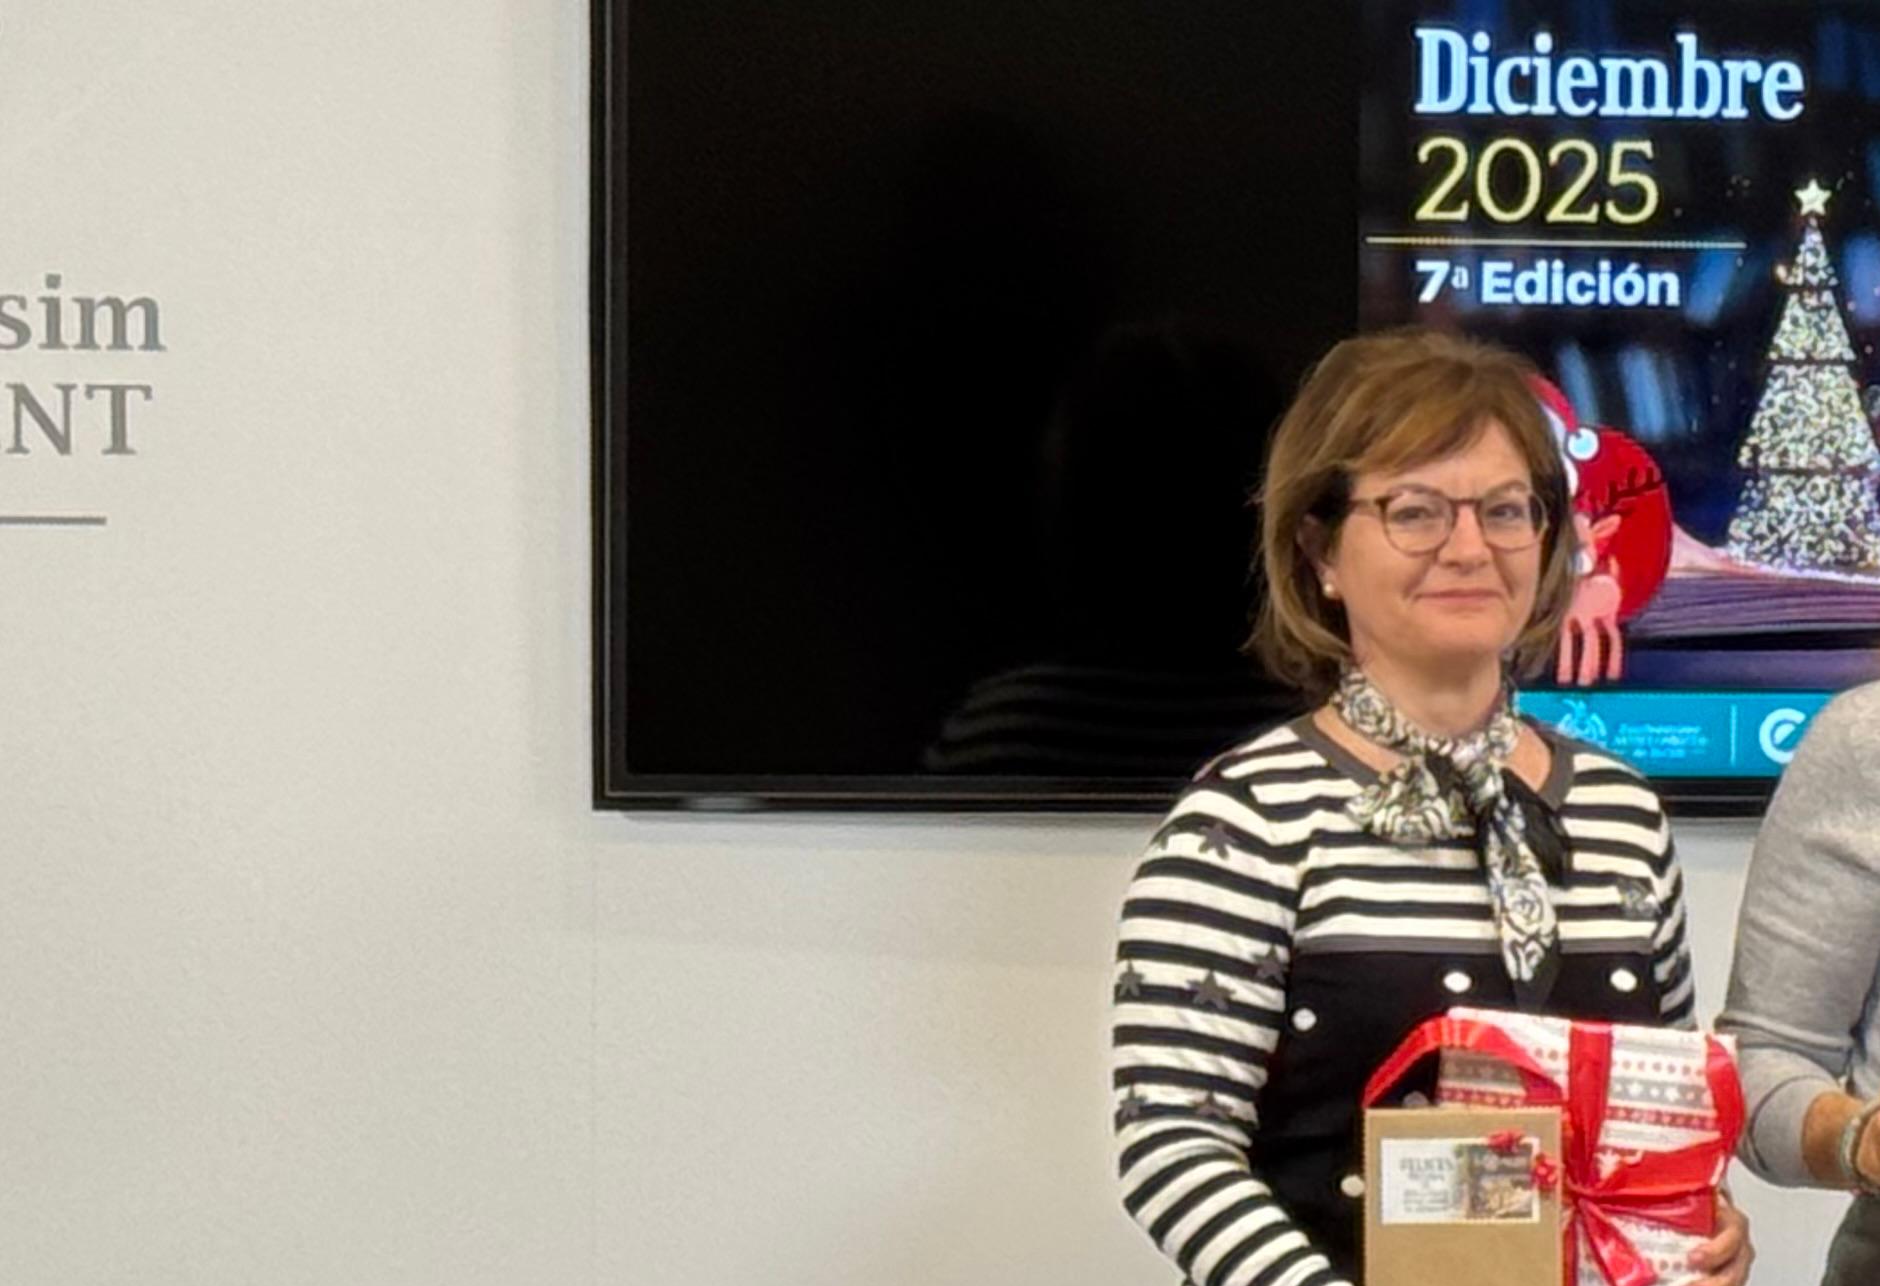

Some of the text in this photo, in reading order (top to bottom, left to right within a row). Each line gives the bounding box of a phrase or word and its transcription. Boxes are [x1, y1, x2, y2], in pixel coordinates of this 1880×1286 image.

[1414, 28, 1804, 120] Diciembre
[1415, 137, 1659, 224] 2025
[1416, 260, 1681, 306] 7ª Edición
